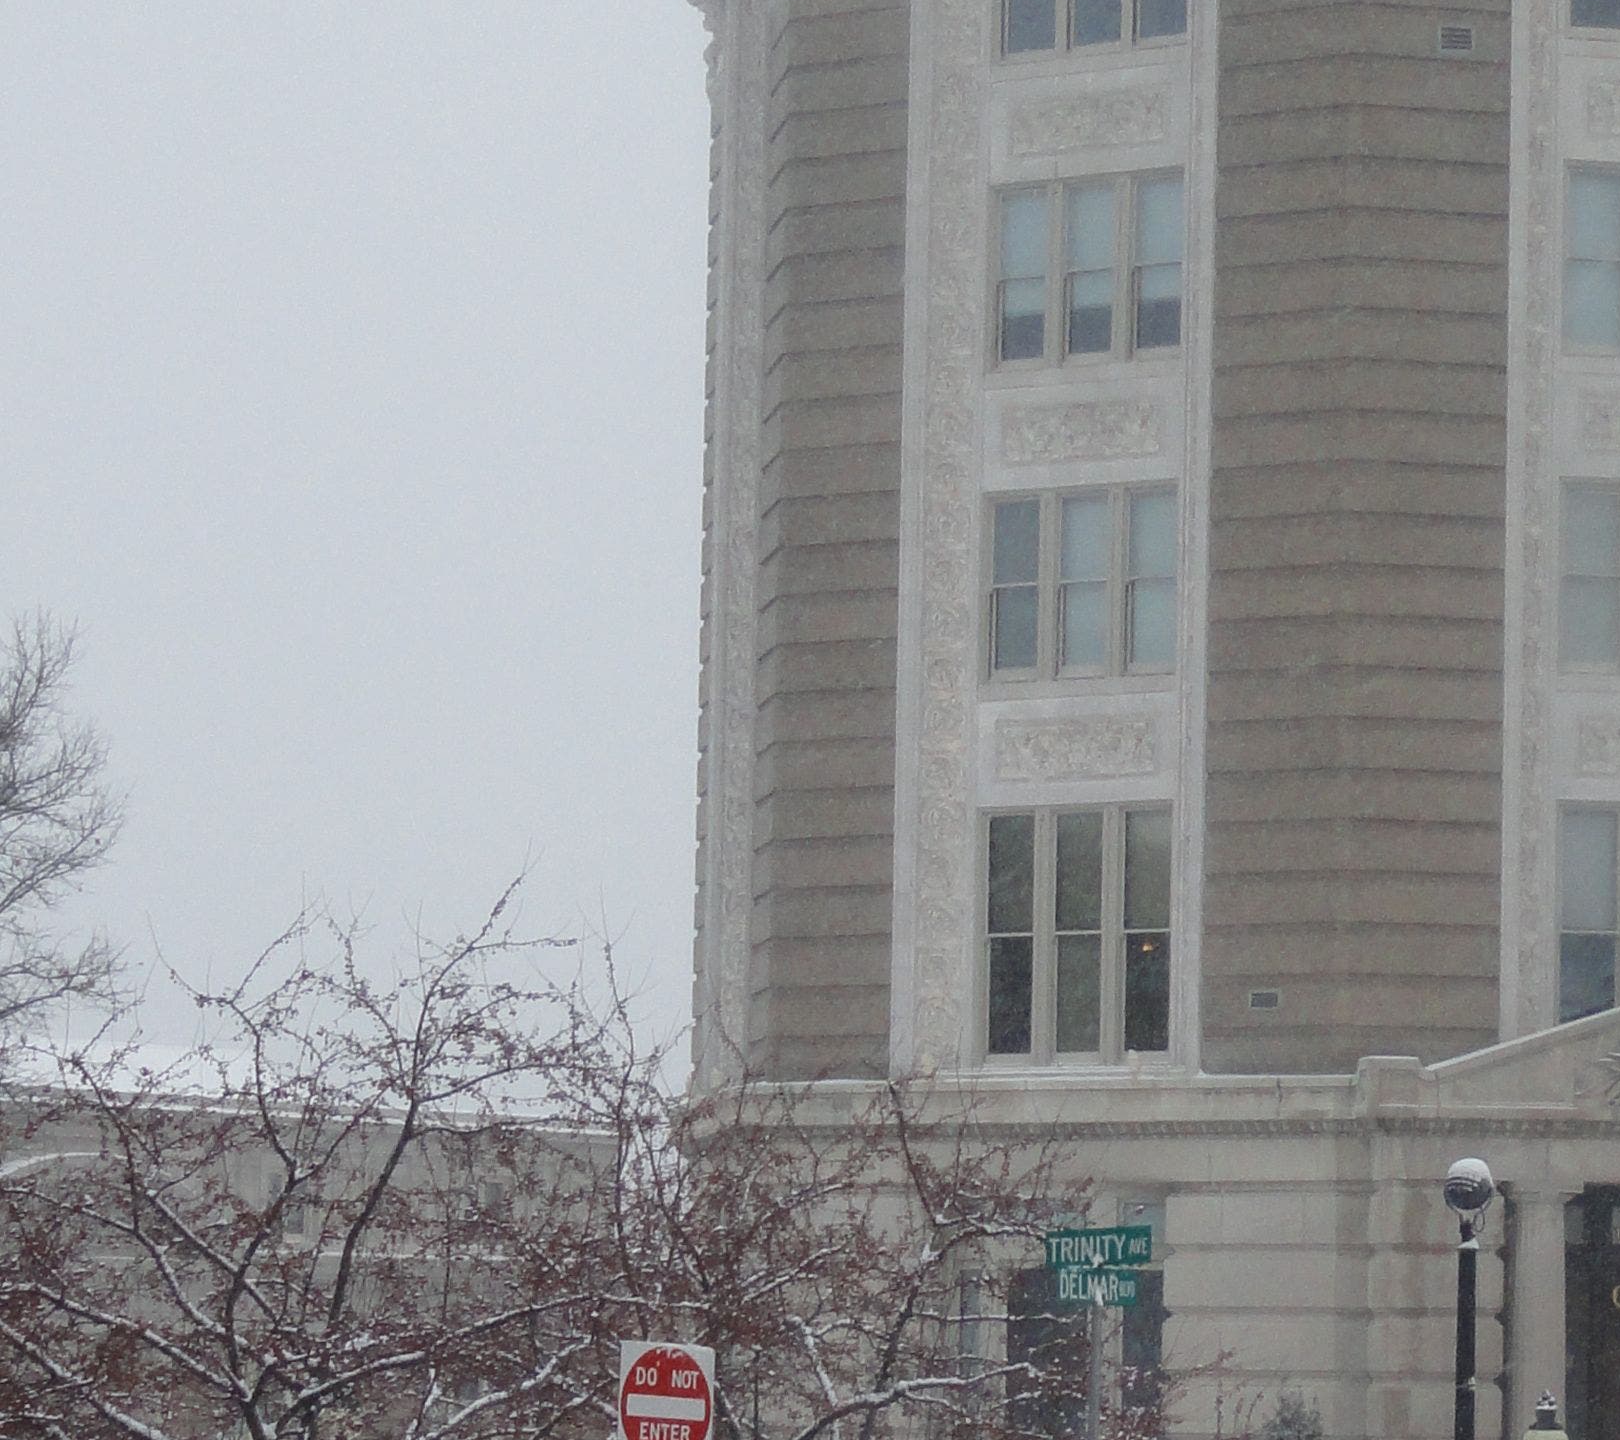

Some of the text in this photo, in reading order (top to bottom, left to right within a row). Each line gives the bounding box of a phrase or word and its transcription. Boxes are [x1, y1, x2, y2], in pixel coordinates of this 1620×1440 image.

[1049, 1234, 1148, 1263] TRINITY AVE
[1060, 1270, 1119, 1301] DELMAR
[635, 1366, 700, 1390] DO NOT
